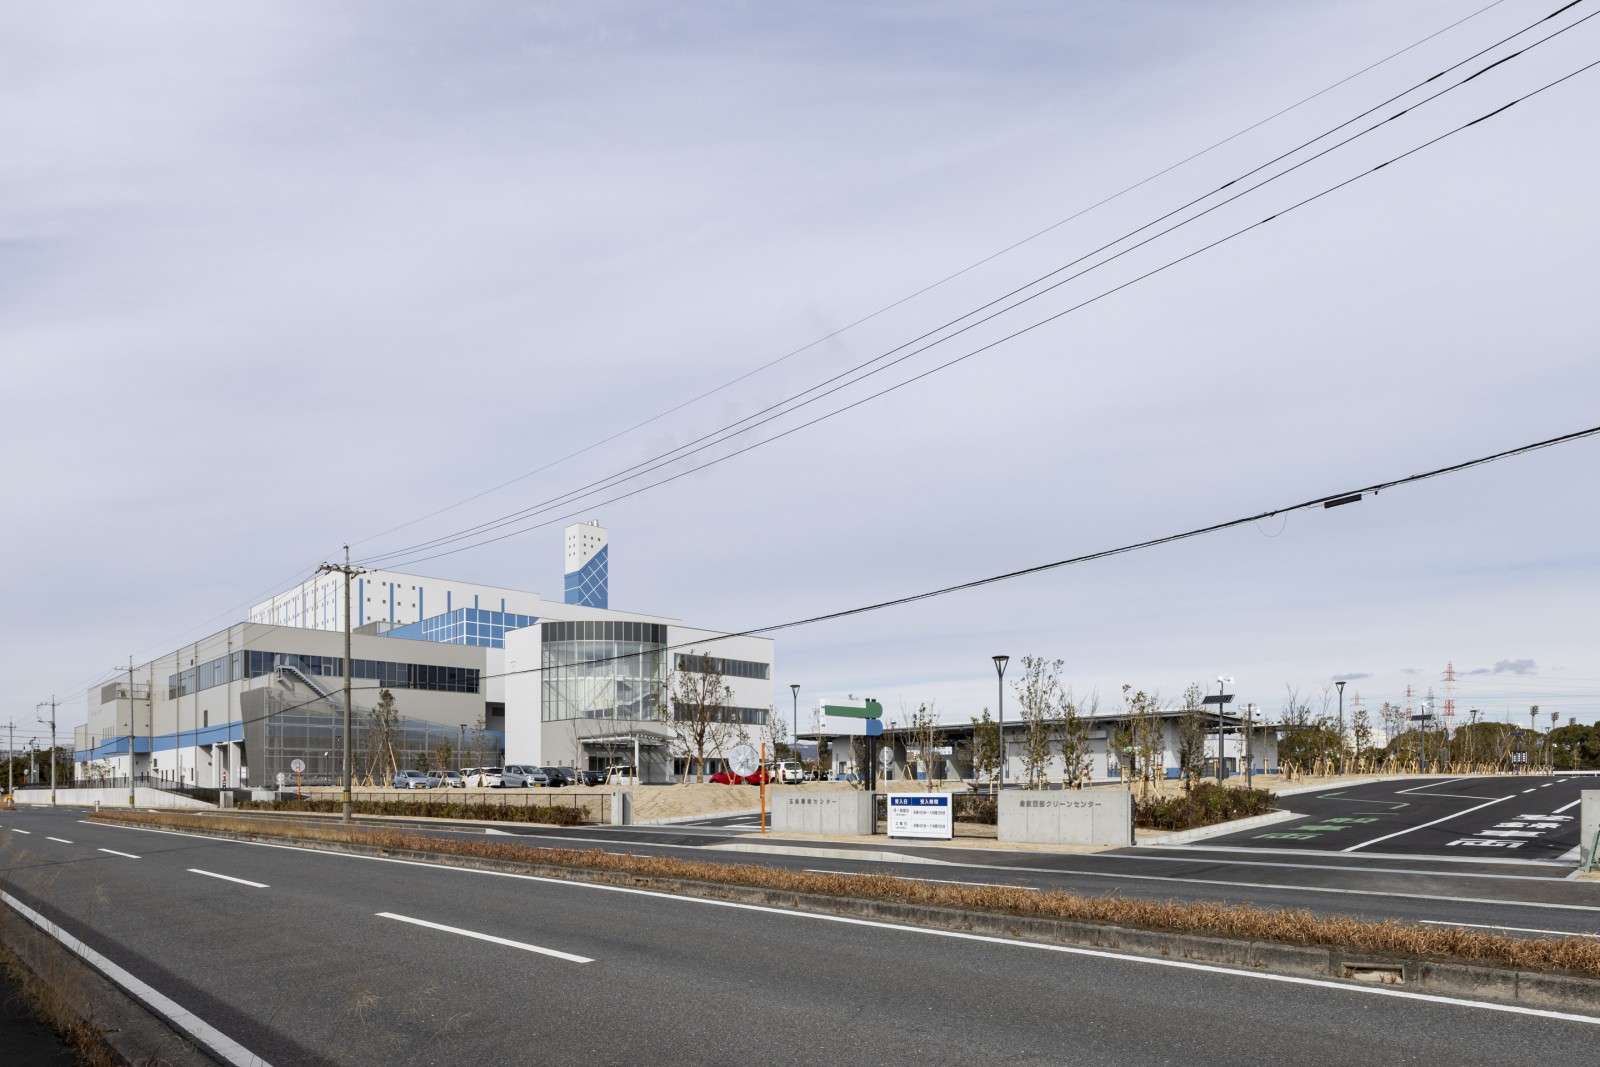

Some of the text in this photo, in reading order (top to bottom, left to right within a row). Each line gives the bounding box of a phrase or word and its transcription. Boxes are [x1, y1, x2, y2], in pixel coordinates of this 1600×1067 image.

[1019, 800, 1102, 808] 倉敷西部クリーンセンター
